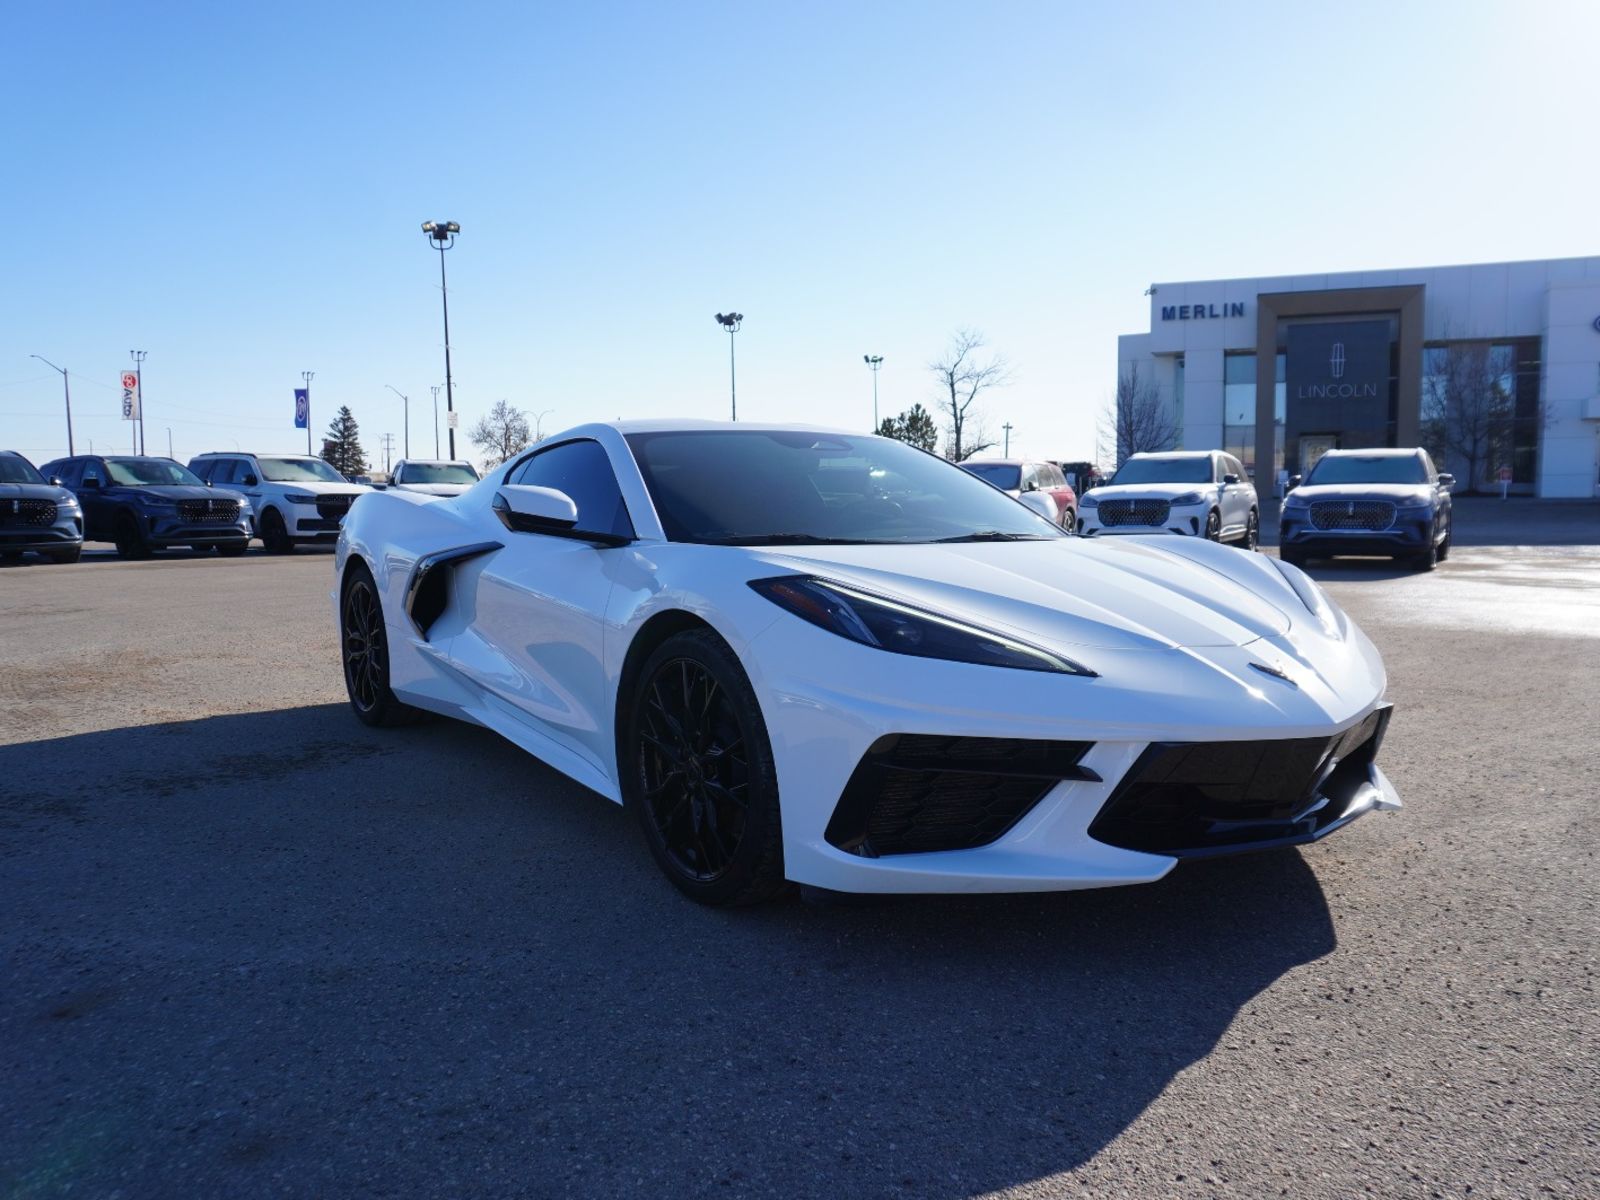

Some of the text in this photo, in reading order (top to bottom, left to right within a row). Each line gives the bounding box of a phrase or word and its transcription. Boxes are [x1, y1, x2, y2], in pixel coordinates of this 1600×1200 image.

[1162, 302, 1244, 321] MERLIN
[1298, 383, 1377, 399] LINCOLN
[123, 388, 133, 417] Auto
